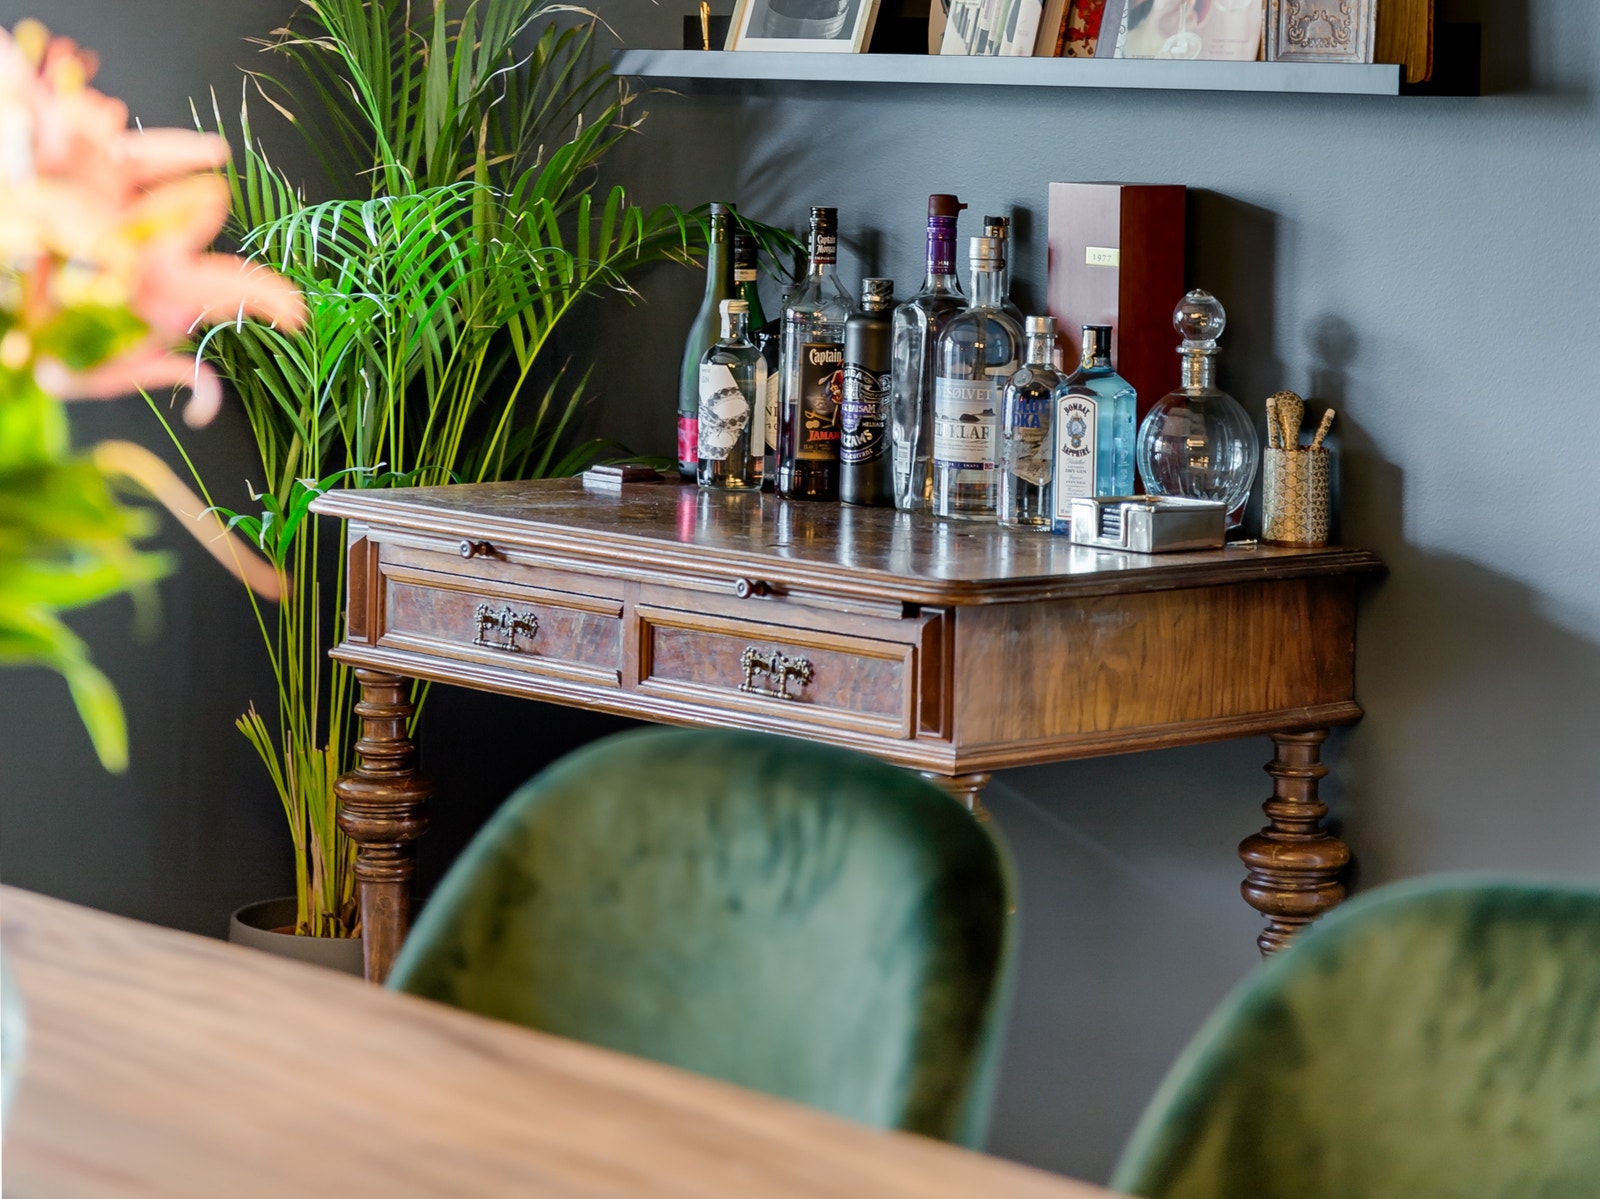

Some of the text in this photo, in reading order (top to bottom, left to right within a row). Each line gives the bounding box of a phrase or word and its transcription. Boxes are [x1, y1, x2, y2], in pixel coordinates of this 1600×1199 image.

[1092, 253, 1112, 262] 1977
[809, 348, 843, 366] Captain
[1063, 402, 1091, 417] BOMBAY
[1061, 442, 1091, 457] SAPPHIRE
